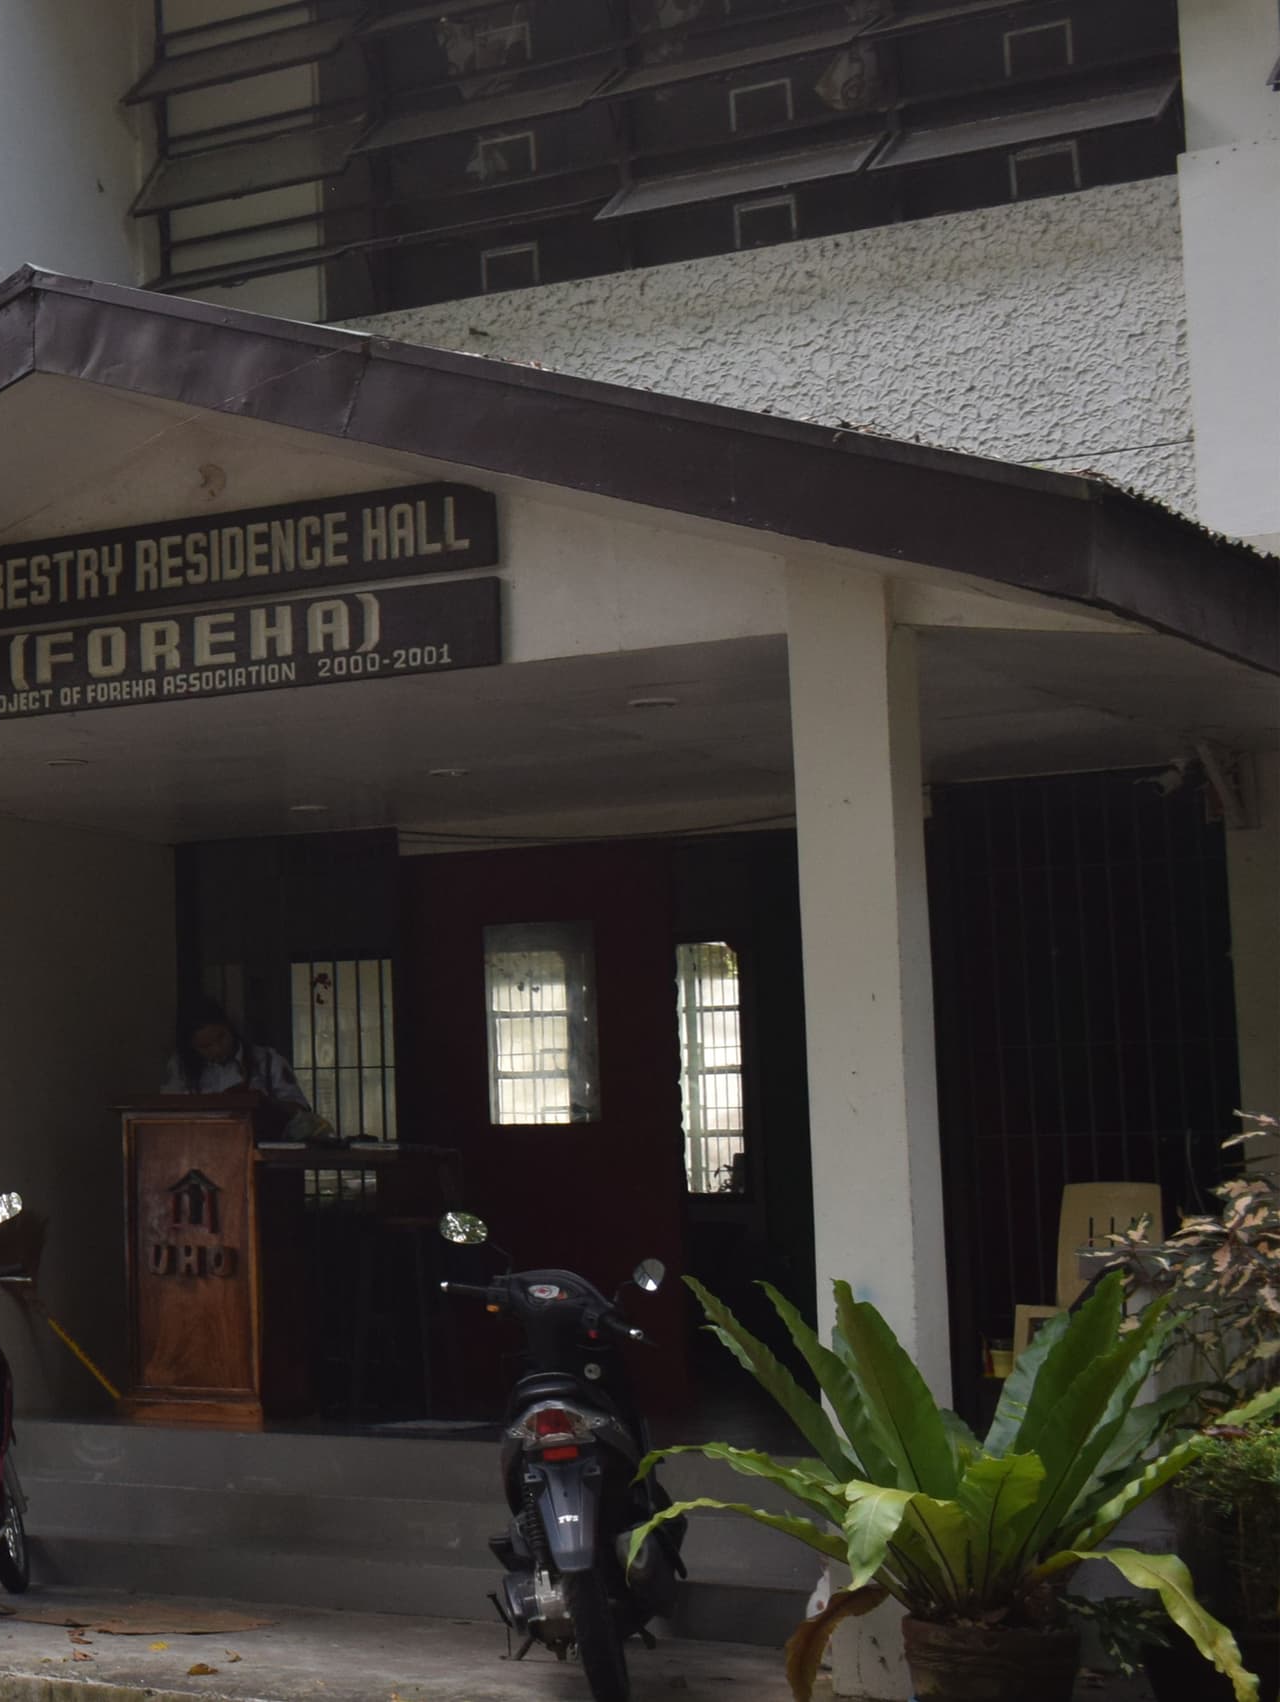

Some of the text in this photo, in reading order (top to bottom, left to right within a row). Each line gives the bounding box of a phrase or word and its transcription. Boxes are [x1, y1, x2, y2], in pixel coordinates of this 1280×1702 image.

[135, 512, 349, 593] RESIDENCE
[361, 496, 470, 562] HALL
[9, 592, 381, 691] (FOREHA)
[60, 685, 81, 706] OF
[86, 679, 157, 704] FOREHA
[162, 661, 297, 694] ASSOCIATION
[317, 643, 453, 677] 2000-2001
